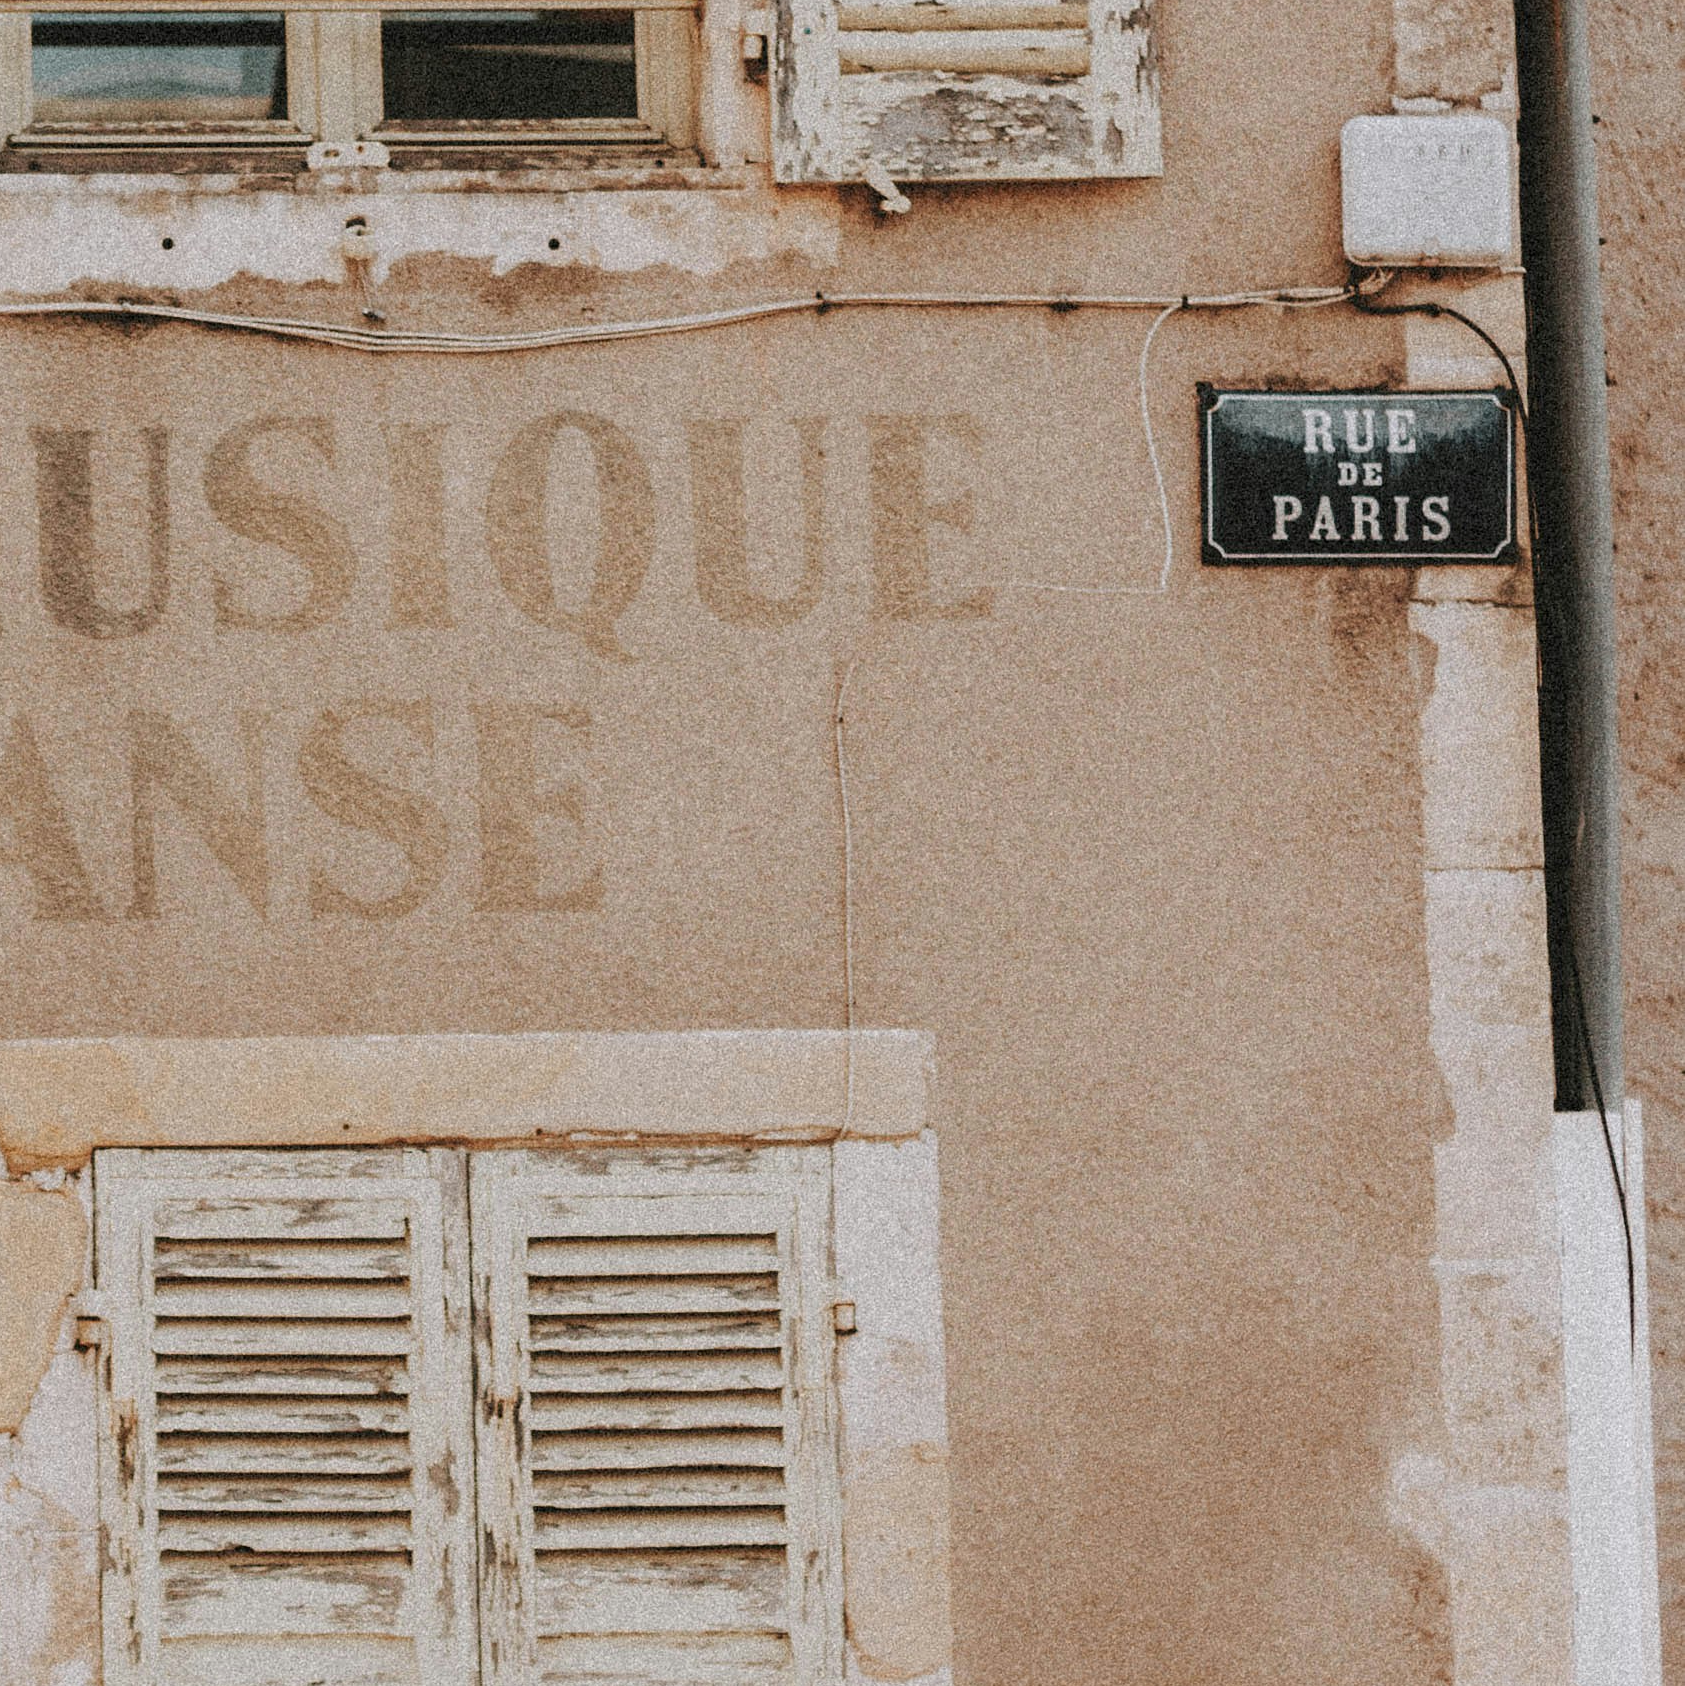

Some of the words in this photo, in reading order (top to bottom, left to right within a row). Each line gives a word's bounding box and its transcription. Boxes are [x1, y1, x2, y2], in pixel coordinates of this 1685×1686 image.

[1303, 408, 1417, 454] RUE
[1337, 462, 1383, 487] DE
[1271, 495, 1452, 542] PARIS
